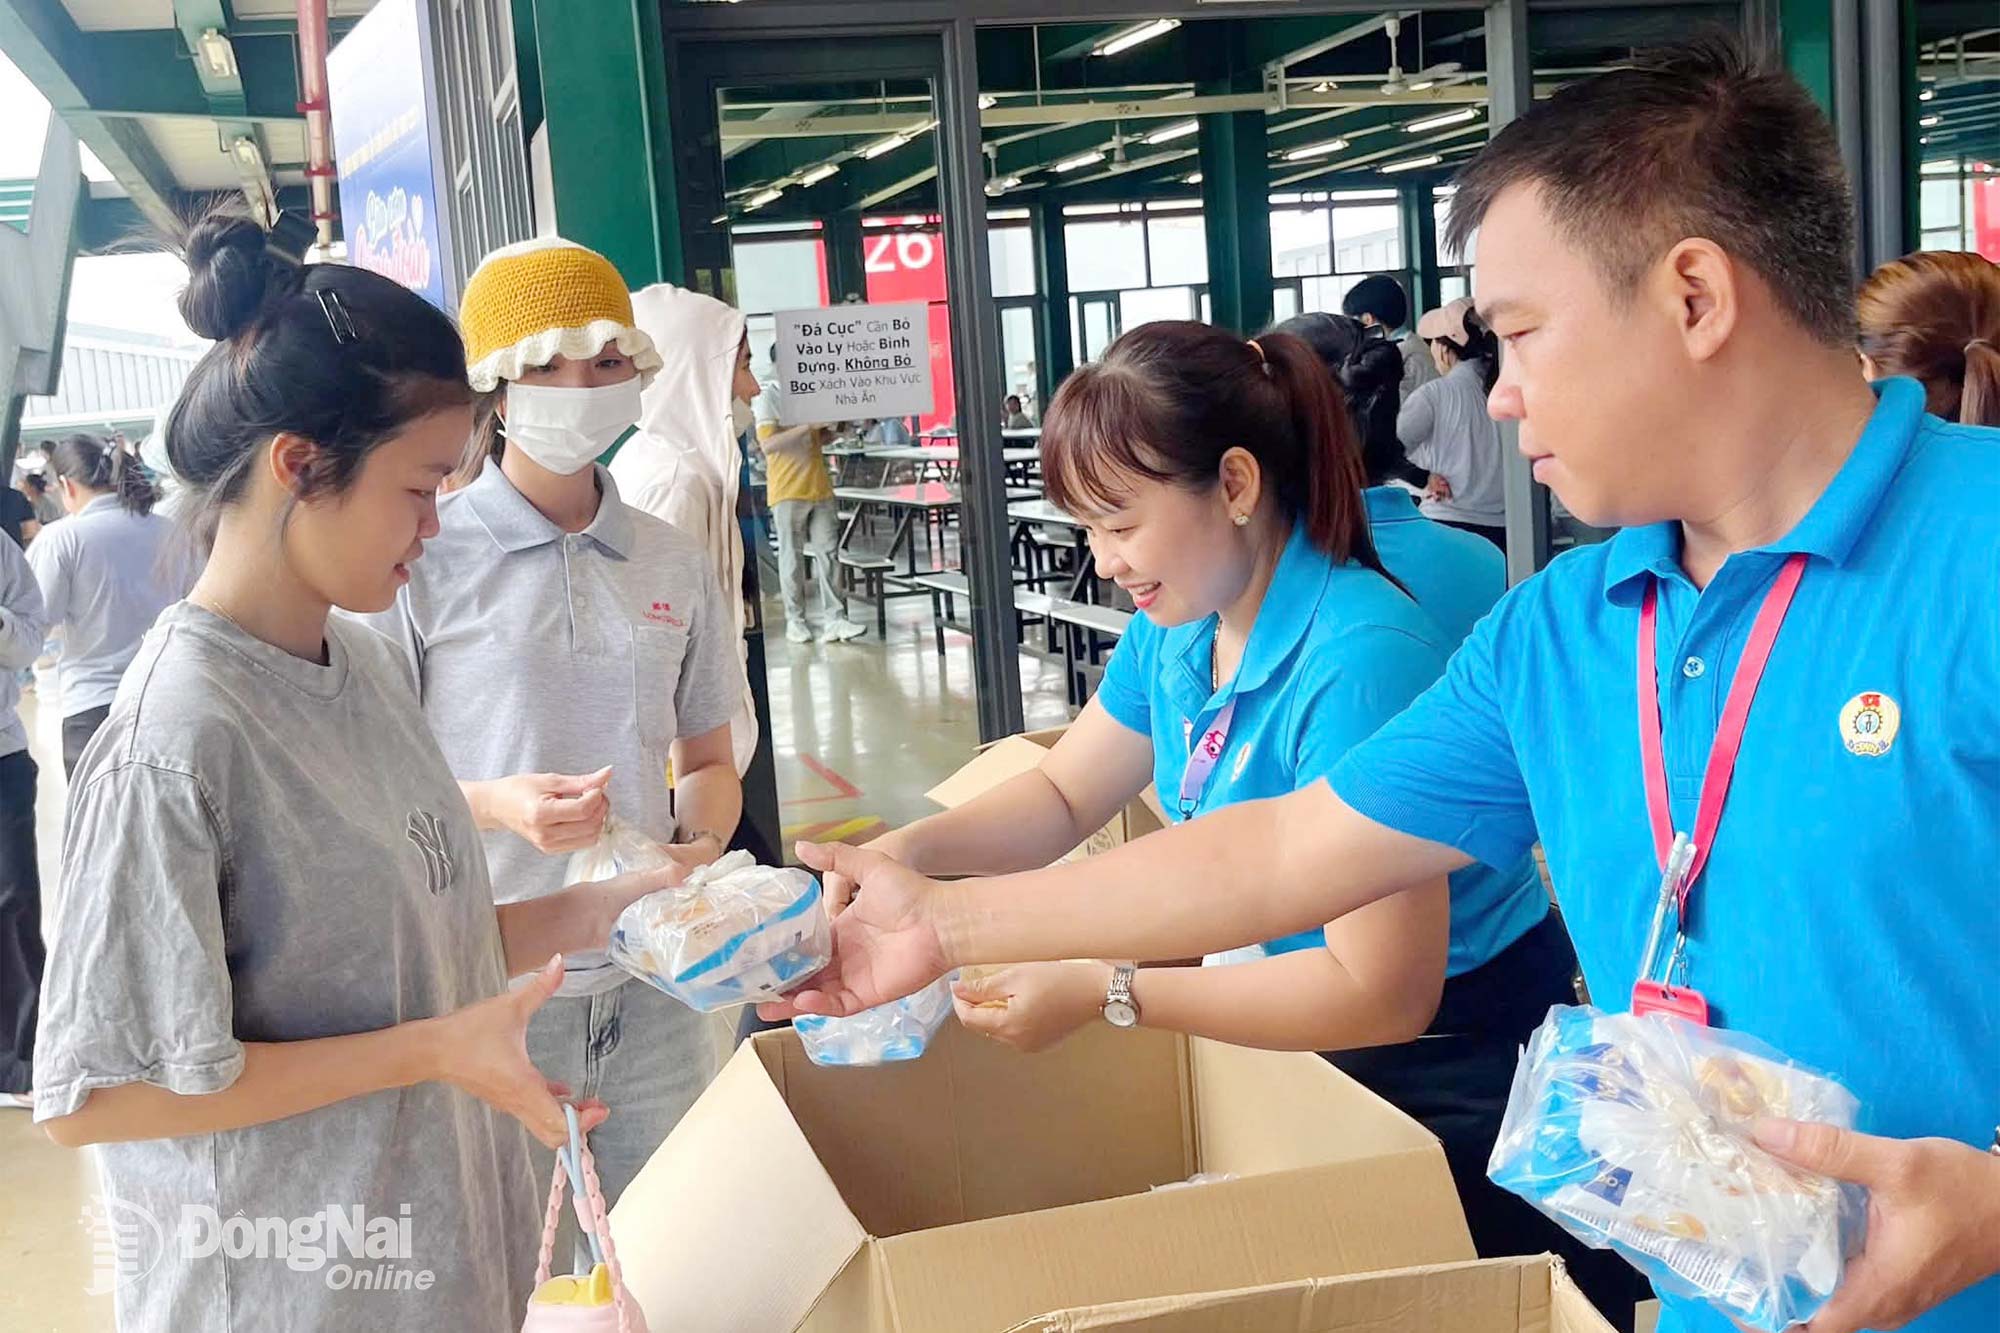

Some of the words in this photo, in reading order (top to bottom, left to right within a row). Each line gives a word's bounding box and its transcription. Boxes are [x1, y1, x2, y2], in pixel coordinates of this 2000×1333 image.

[892, 317, 911, 331] Bỏ
[796, 341, 823, 355] Vào
[827, 341, 843, 356] Ly
[845, 356, 889, 372] Không
[893, 353, 912, 368] Bỏ
[850, 376, 873, 388] Vào
[875, 374, 897, 386] Khu
[835, 392, 858, 406] Nhà
[861, 391, 877, 404] Ăn
